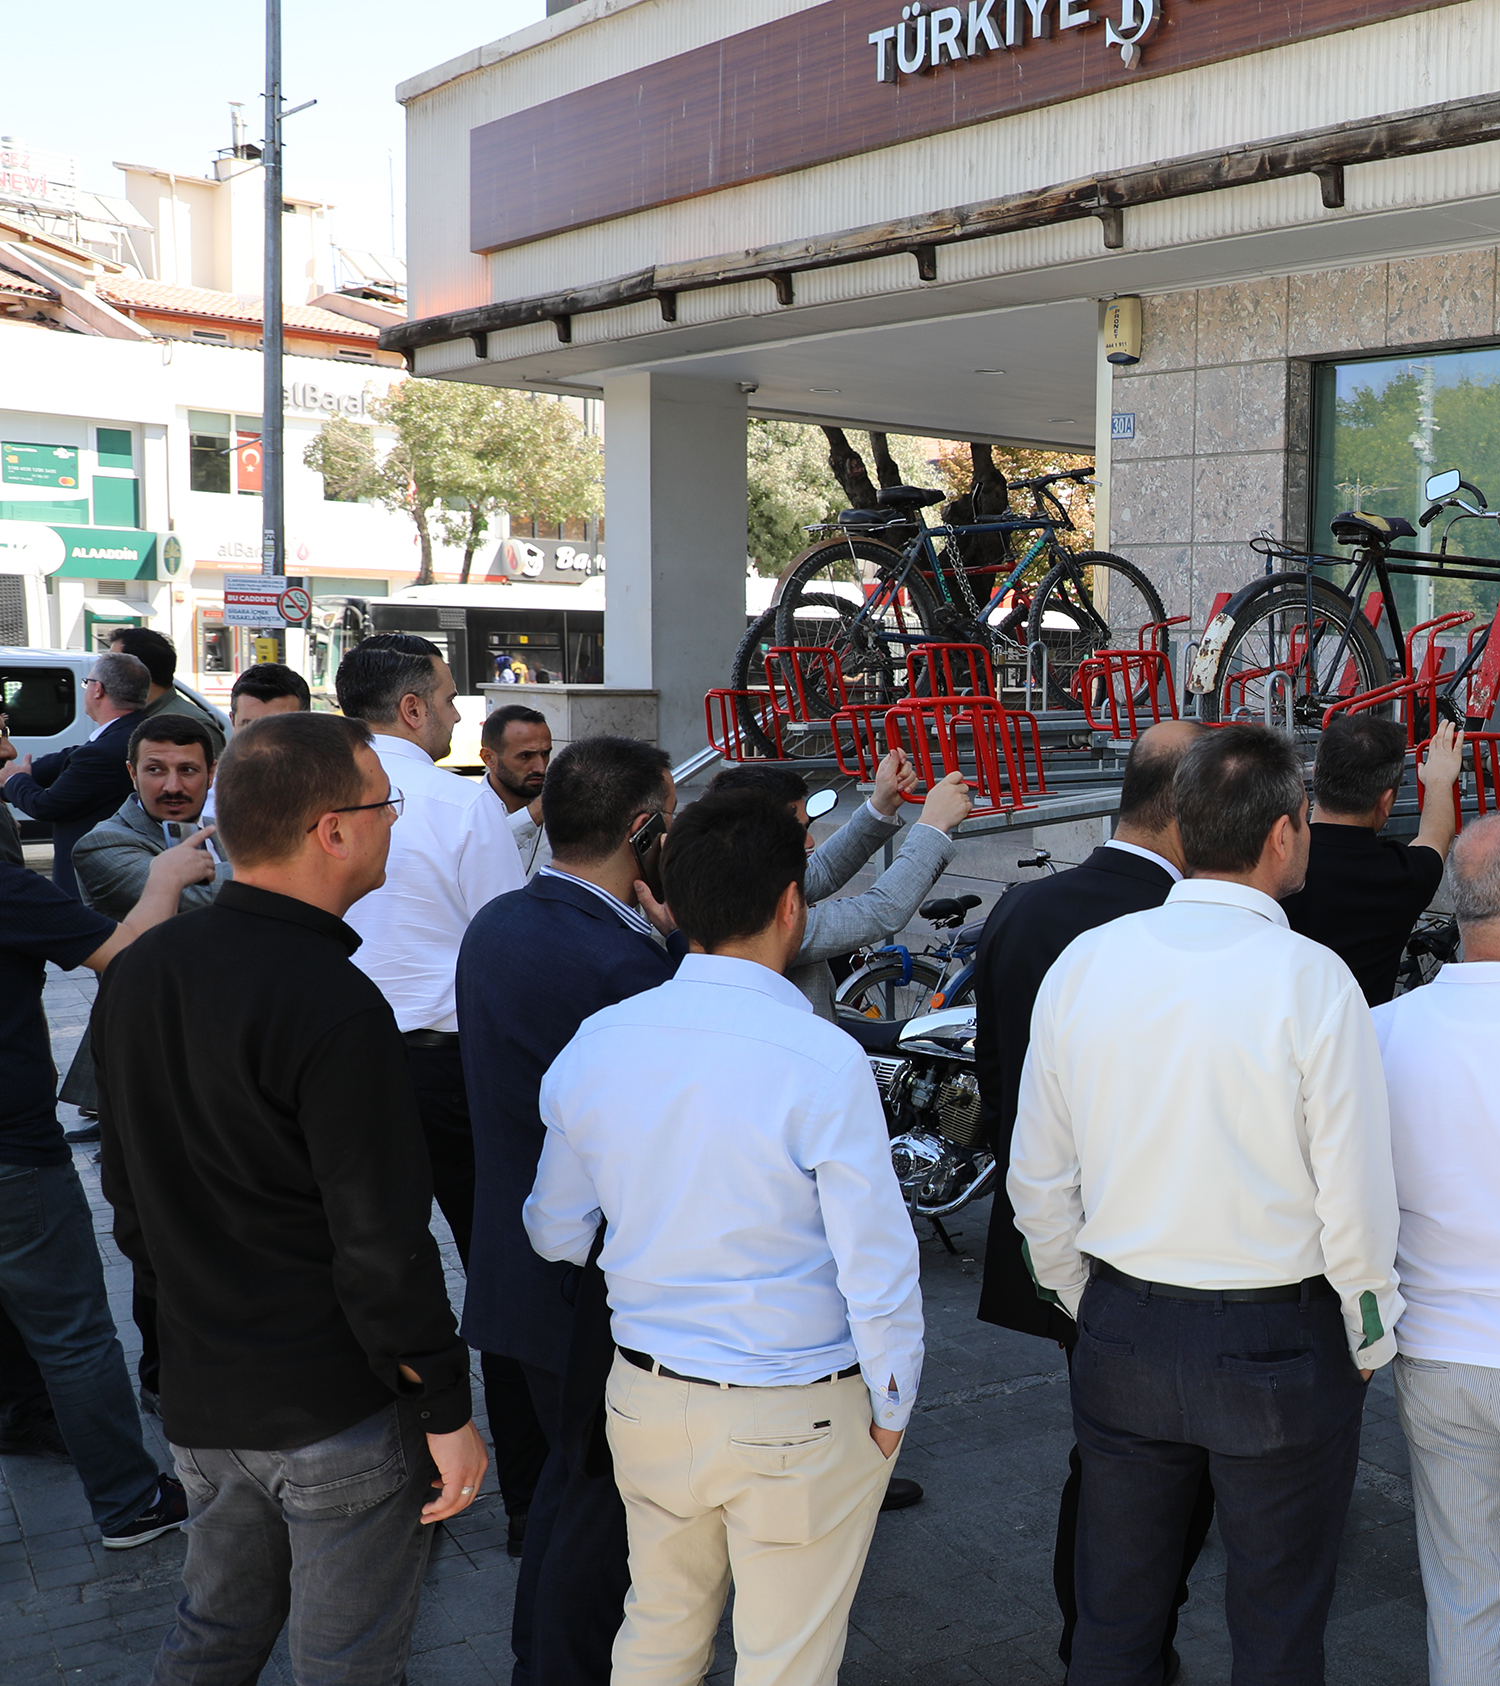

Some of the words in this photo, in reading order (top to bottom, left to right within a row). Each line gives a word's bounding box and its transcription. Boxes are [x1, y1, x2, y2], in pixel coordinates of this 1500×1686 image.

[1113, 308, 1121, 339] PRONET
[283, 381, 367, 415] alBara
[72, 546, 139, 561] ALAADDİN
[227, 594, 239, 602] BU
[239, 595, 277, 603] CADDE'DE
[227, 607, 250, 615] SİGARA
